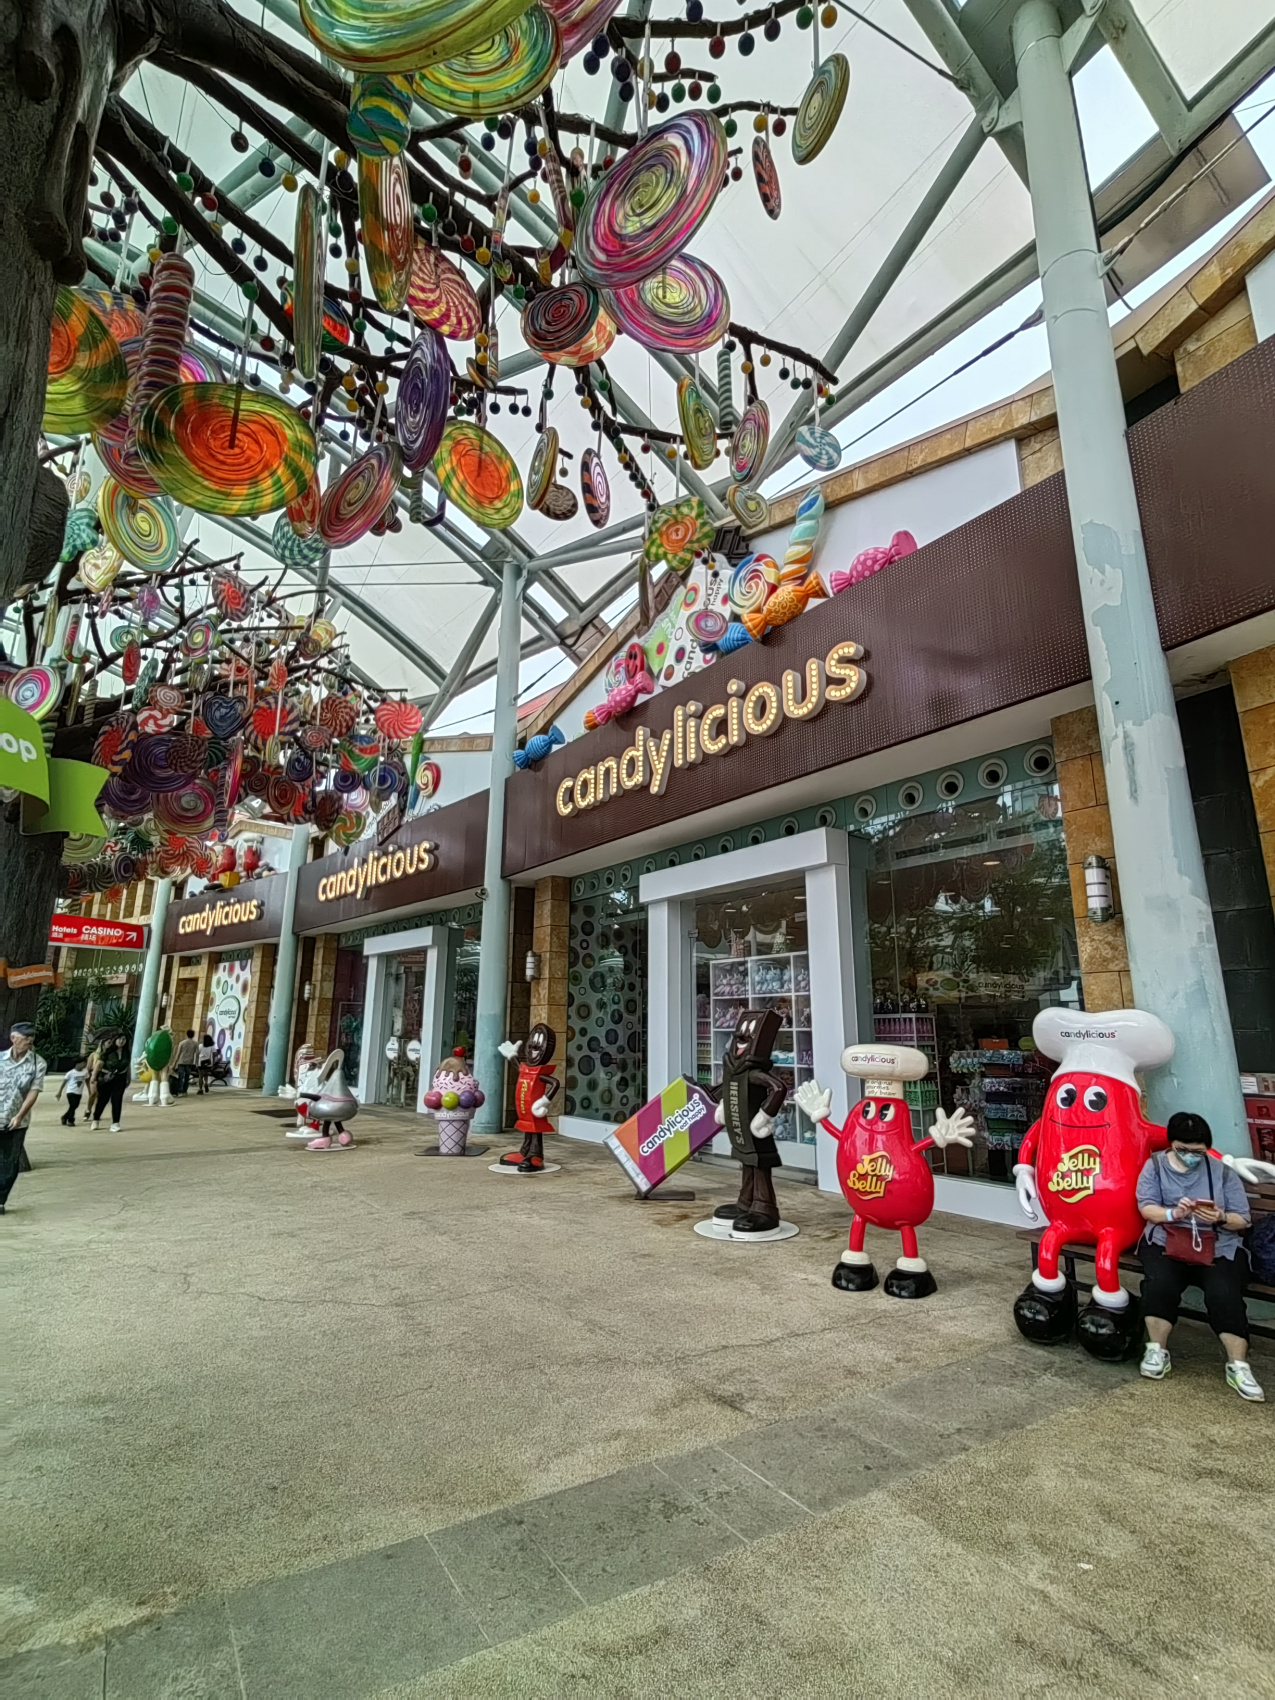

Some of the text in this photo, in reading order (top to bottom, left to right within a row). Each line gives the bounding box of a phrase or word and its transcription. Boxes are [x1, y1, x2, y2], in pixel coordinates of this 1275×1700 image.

[557, 641, 864, 816] candylicious
[0, 733, 37, 763] op
[318, 841, 433, 901] candylicious
[179, 898, 260, 935] candylicious
[52, 925, 122, 936] Hotels CASINO
[1061, 1030, 1116, 1040] candylicious
[852, 1055, 896, 1064] candylicious
[641, 1098, 701, 1155] candylicious
[680, 1105, 706, 1131] eat happy
[856, 1154, 895, 1181] Jelly
[1057, 1151, 1100, 1174] Jelly
[847, 1170, 886, 1197] Belly
[1048, 1171, 1094, 1194] Belly
